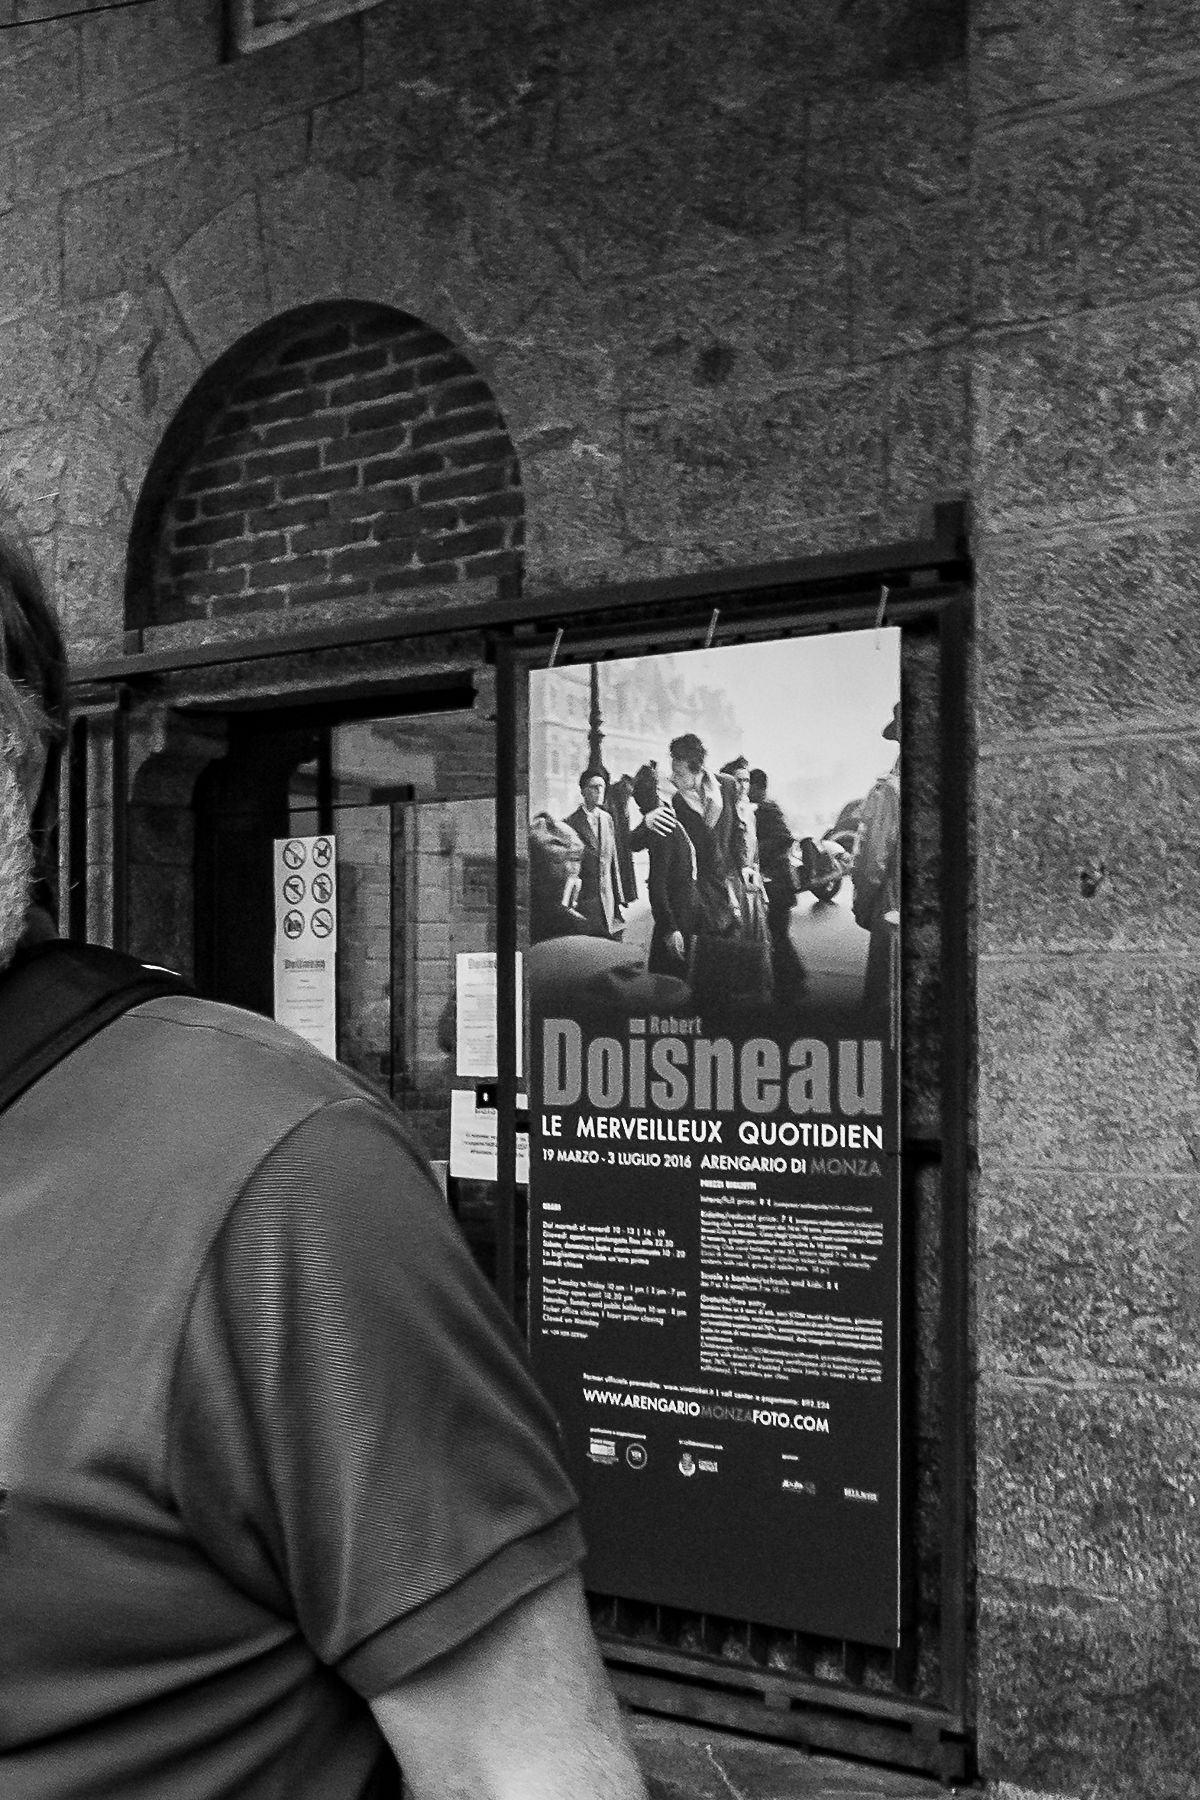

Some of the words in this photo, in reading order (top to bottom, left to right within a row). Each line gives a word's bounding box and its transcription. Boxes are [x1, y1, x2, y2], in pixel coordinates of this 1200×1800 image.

[650, 1016, 701, 1035] Robert
[543, 1018, 883, 1115] Doisneau
[541, 1115, 562, 1136] LE
[576, 1115, 723, 1143] MERVEILLEUX
[738, 1122, 883, 1149] QUOTIDIEN
[543, 1149, 554, 1161] 19
[557, 1149, 599, 1164] MARZO
[608, 1152, 615, 1165] 3
[618, 1152, 661, 1167] LUGLIO
[664, 1154, 692, 1169] 2016
[700, 1154, 787, 1173] ARENGARIO
[791, 1159, 806, 1174] DI
[810, 1158, 882, 1177] MONZA
[583, 1388, 830, 1434] WWW.ARENGARIOMONZAFOTO.COM
